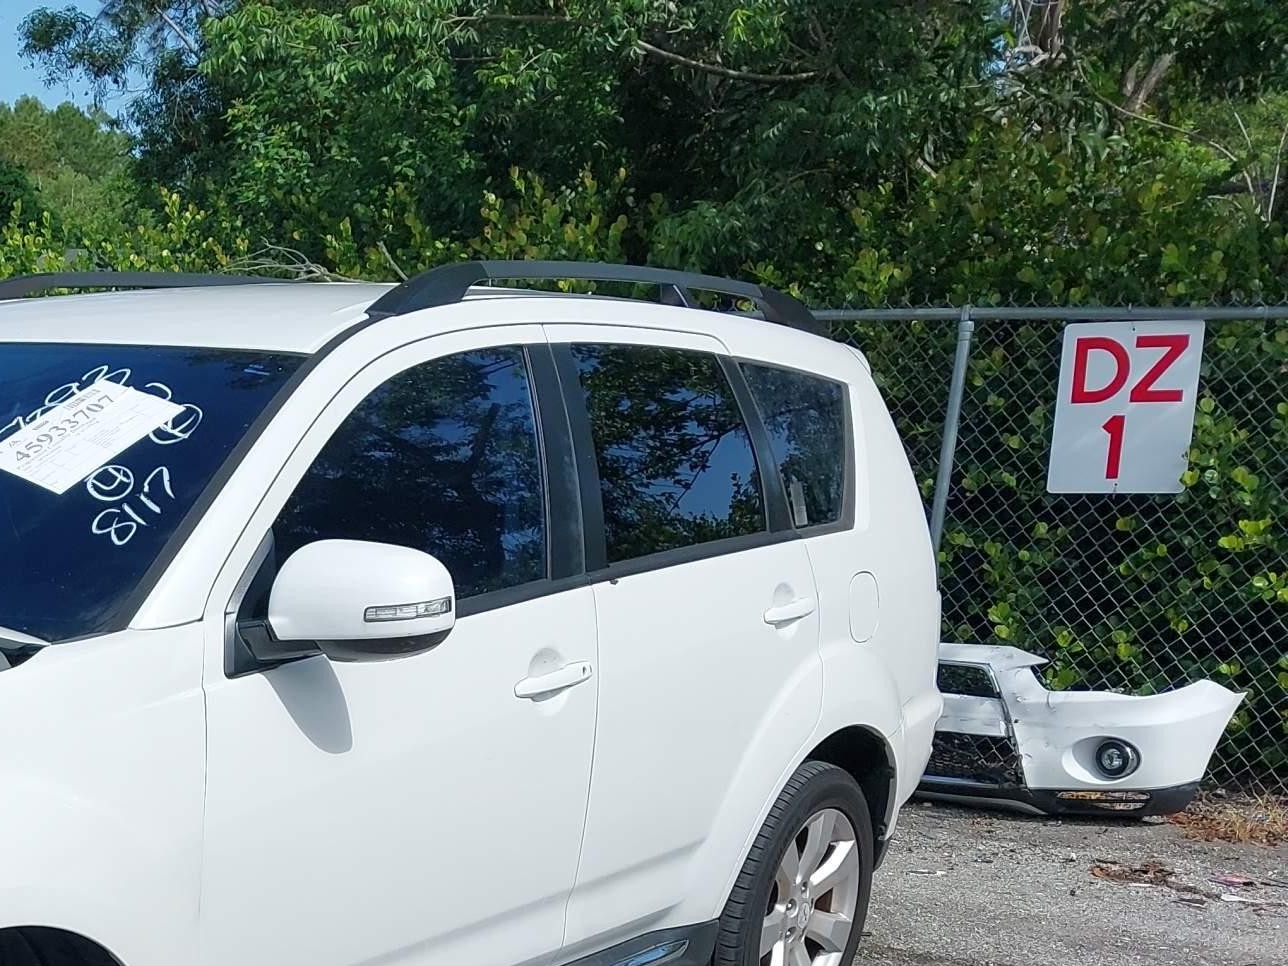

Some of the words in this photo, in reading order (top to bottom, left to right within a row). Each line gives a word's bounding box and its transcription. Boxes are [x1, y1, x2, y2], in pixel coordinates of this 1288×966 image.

[1070, 334, 1190, 404] DZ
[15, 394, 115, 463] 45933707
[1102, 415, 1126, 479] 1
